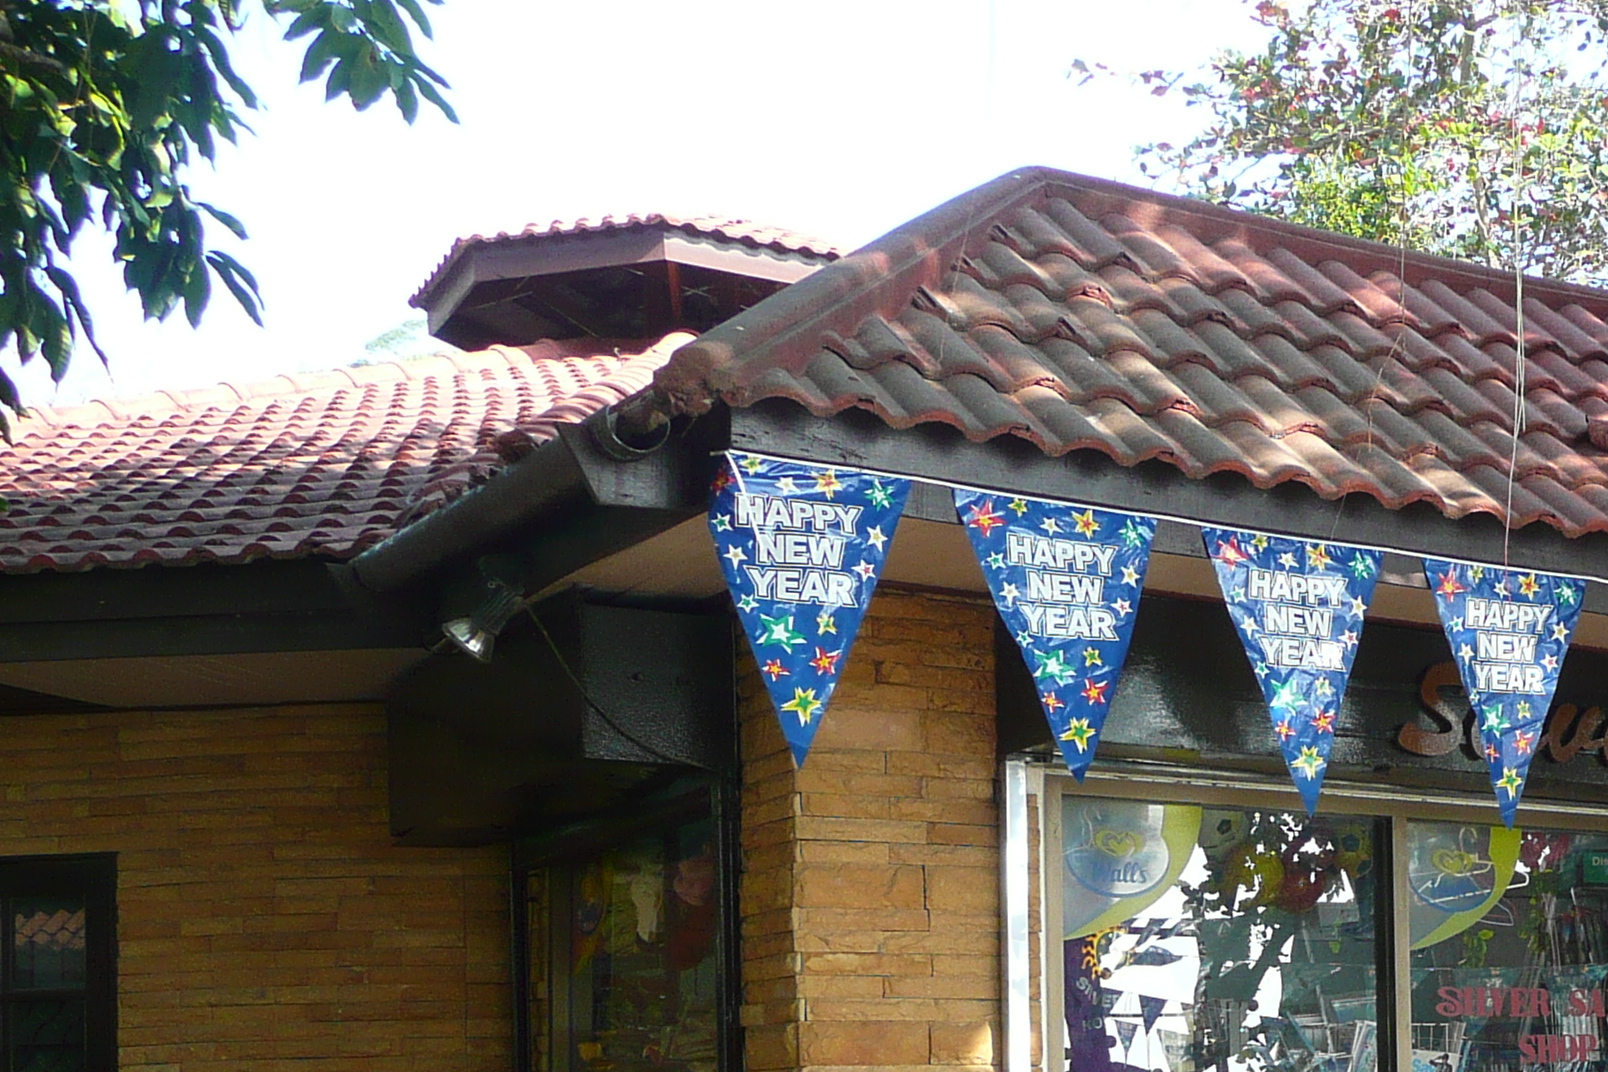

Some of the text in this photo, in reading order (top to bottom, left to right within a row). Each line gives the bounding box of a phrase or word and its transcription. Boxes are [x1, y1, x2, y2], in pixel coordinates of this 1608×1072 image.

[735, 491, 863, 535] HAPPY
[755, 529, 846, 569] NEW
[1006, 530, 1118, 576] HAPPY
[744, 564, 858, 608] YEAR
[1026, 570, 1103, 605] NEW
[1248, 568, 1348, 608] HAPPY
[1017, 603, 1118, 641] YEAR
[1266, 604, 1332, 637] NEW
[1465, 598, 1554, 634] HAPPY
[1259, 636, 1346, 671] YEAR
[1477, 632, 1537, 664] NEW
[1473, 662, 1545, 695] YEAR
[1435, 986, 1551, 1018] SILVER
[1518, 1034, 1598, 1064] SHOP
